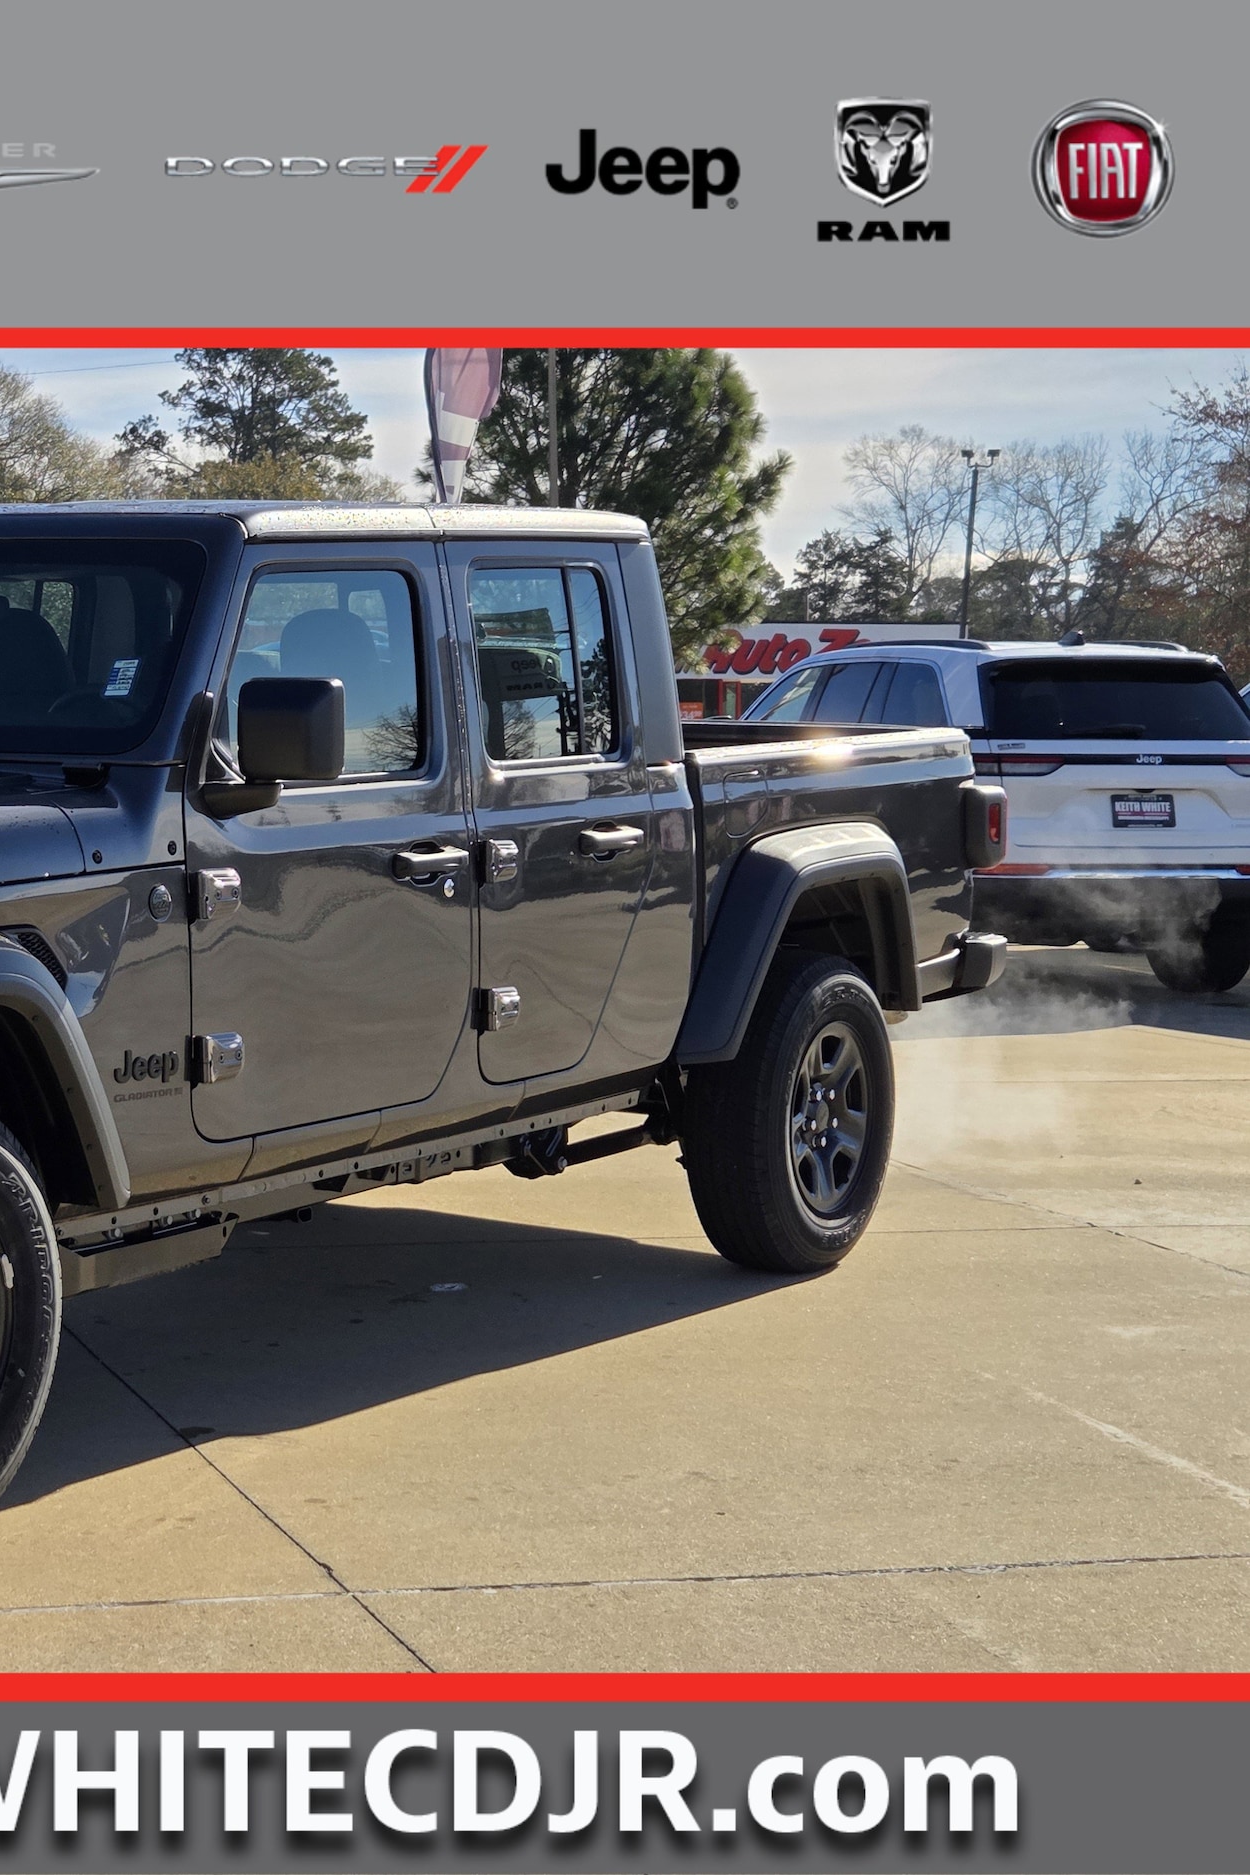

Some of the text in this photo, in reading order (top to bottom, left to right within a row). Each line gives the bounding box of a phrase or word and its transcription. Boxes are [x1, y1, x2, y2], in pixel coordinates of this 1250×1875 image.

[1136, 754, 1162, 765] Jeep
[1114, 801, 1171, 812] KEITH WHITE
[113, 1049, 179, 1084] Jeep
[114, 1088, 173, 1103] GLADIATOR
